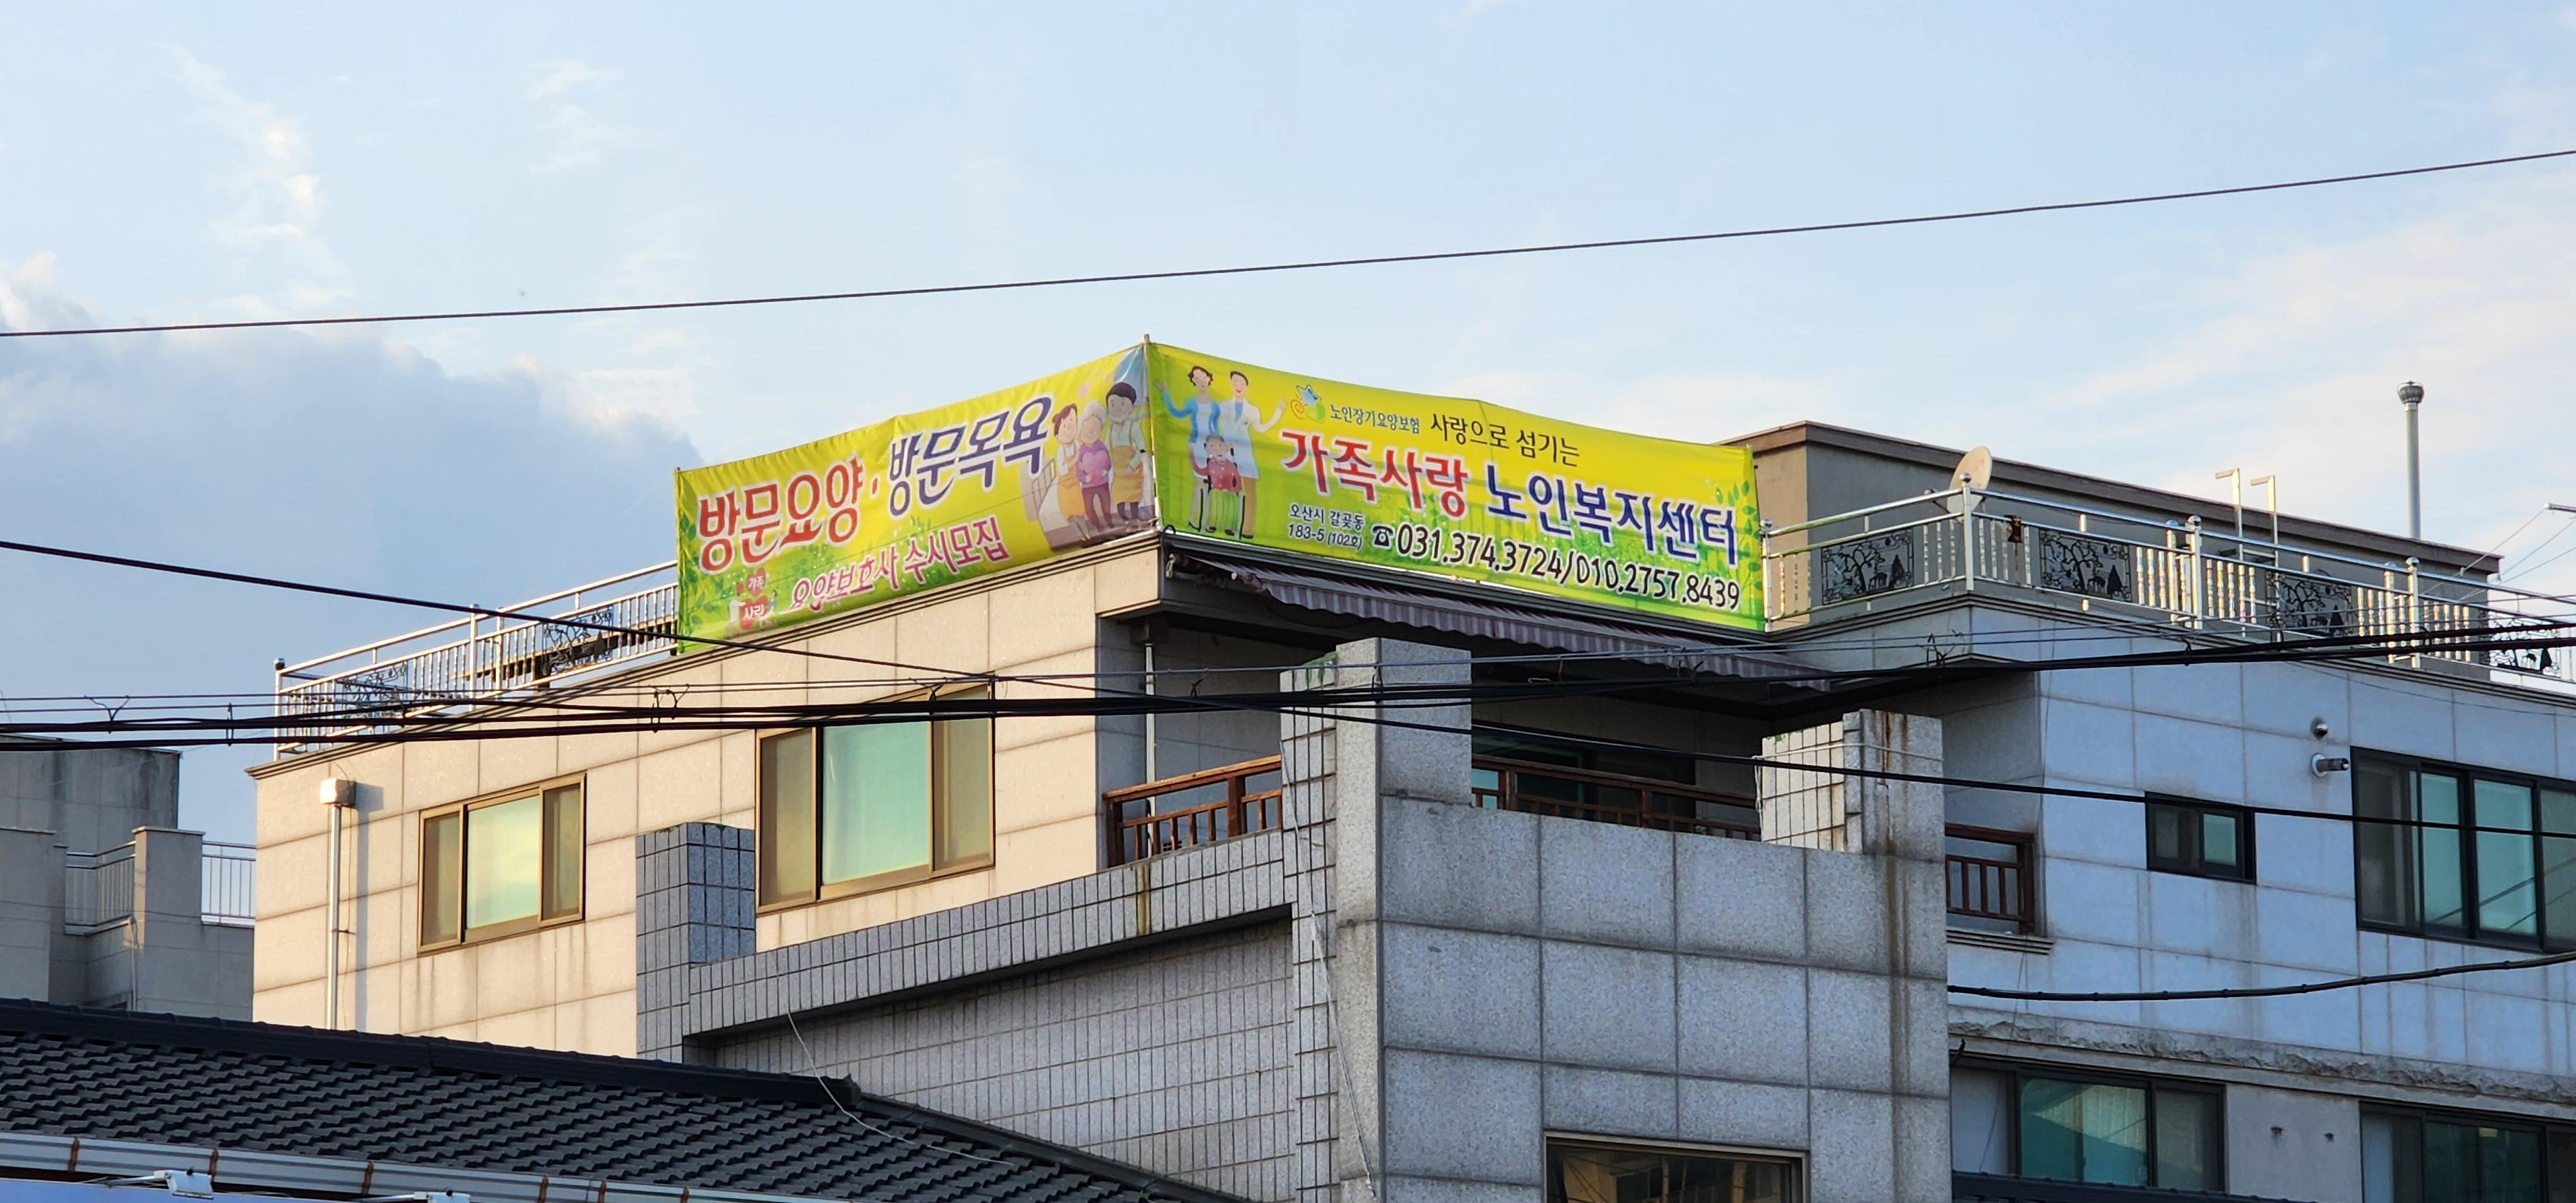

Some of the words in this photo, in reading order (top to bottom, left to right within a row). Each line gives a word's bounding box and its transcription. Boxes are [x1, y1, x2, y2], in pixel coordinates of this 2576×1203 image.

[1329, 404, 1420, 435] 노인장기요양보험
[1430, 413, 1510, 450] 사랑으로
[1515, 430, 1580, 468] 섬기는
[699, 457, 864, 572] 방문요양
[889, 397, 1052, 516] 방문목욕
[1282, 431, 1468, 517] 가족사랑
[1486, 464, 1736, 565] 노인복지센터
[1288, 524, 1325, 542] 183-5
[1327, 532, 1363, 551] (102호)
[1289, 504, 1325, 524] 오산시
[1329, 511, 1365, 531] 갈곶동
[788, 546, 899, 611] 요양보호사
[904, 516, 1010, 583] 수시모집
